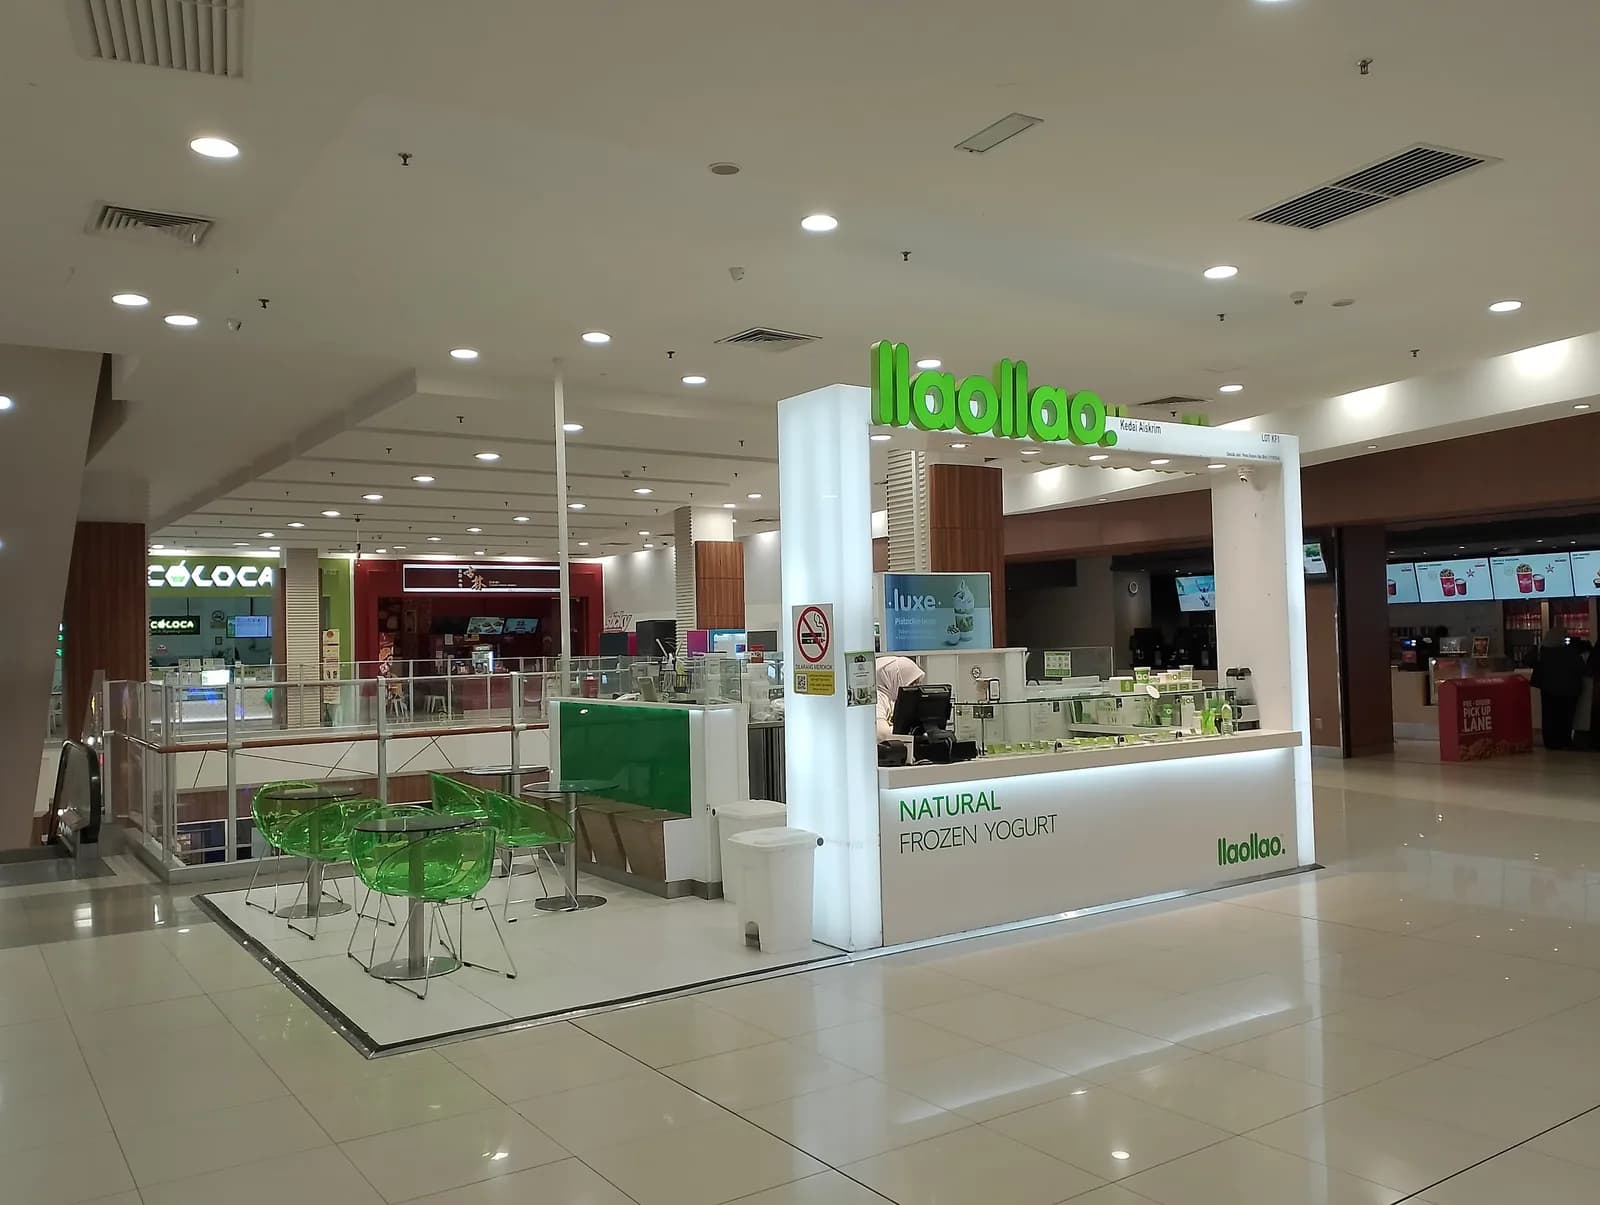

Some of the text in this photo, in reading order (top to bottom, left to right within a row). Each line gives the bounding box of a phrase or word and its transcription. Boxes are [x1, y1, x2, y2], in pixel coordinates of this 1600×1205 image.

[1119, 419, 1162, 435] Kedai Aiskrim
[150, 618, 194, 629] COLOCA
[1463, 705, 1491, 718] PICK UP
[1463, 716, 1493, 732] LANE
[899, 790, 1001, 822] NATURAL
[899, 814, 1058, 854] FROZEN YOGURT
